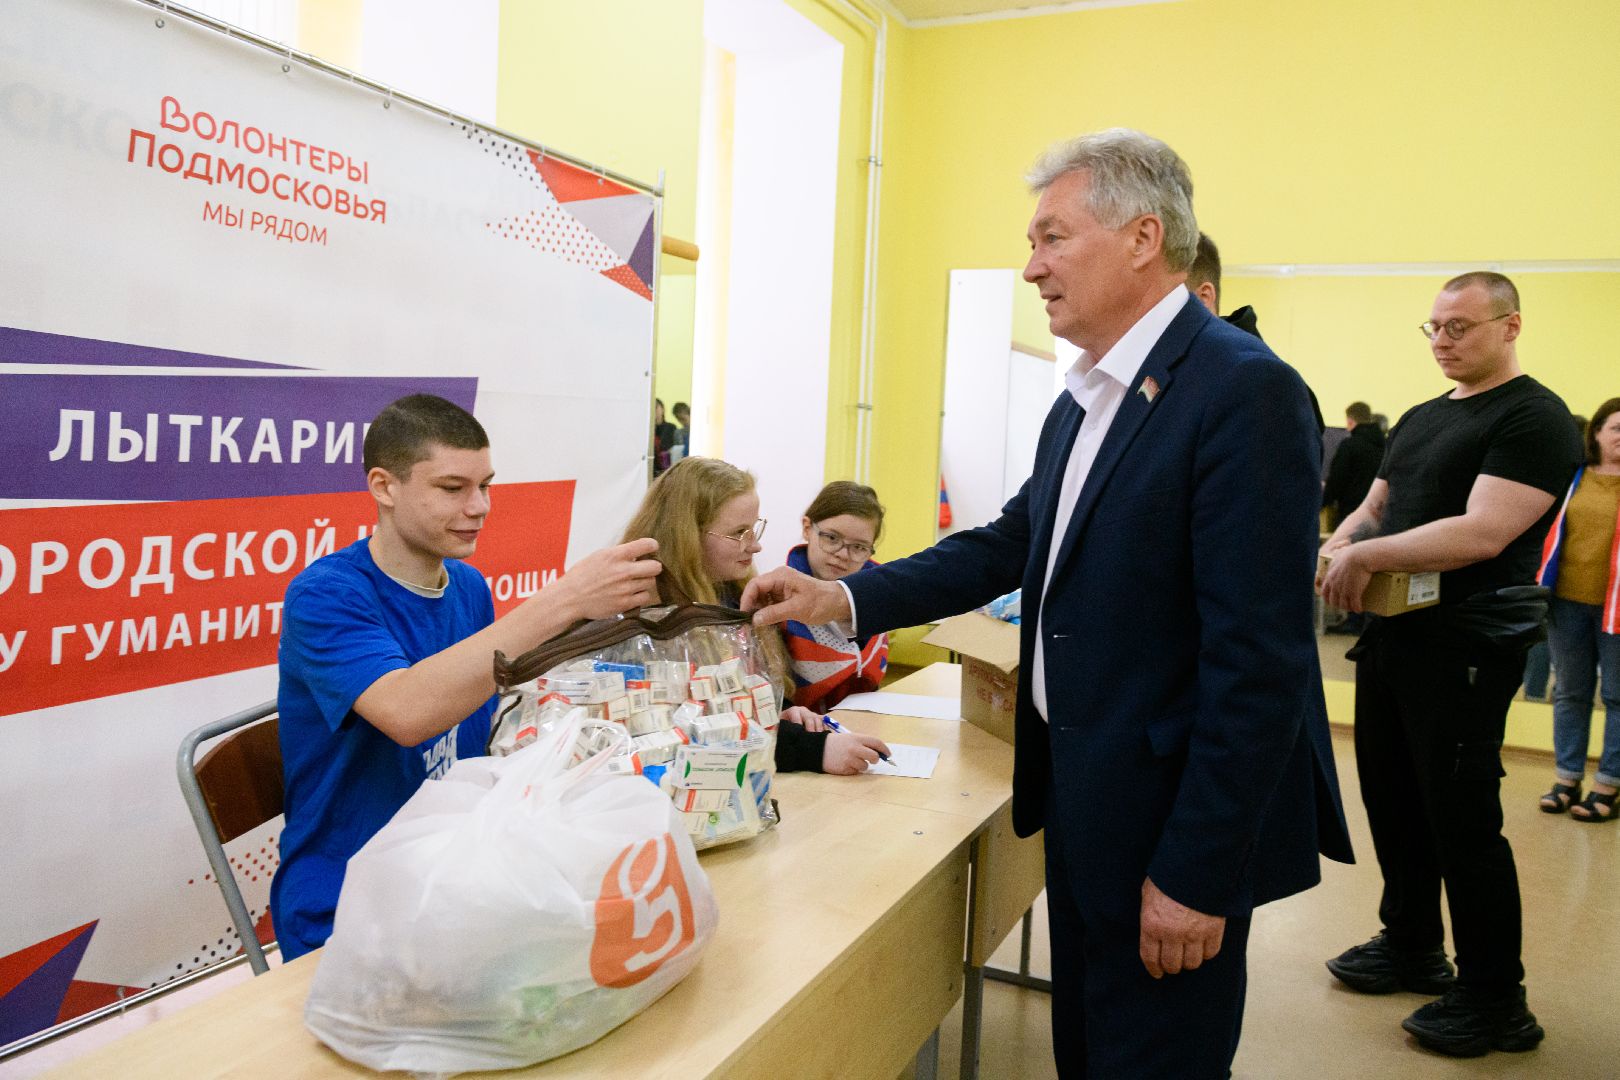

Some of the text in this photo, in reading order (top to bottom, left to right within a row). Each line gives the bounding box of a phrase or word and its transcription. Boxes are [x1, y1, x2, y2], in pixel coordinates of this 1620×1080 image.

[127, 128, 387, 224] ПОДМОСКОВЬЯ
[203, 201, 329, 246] МЫ РЯДОМ
